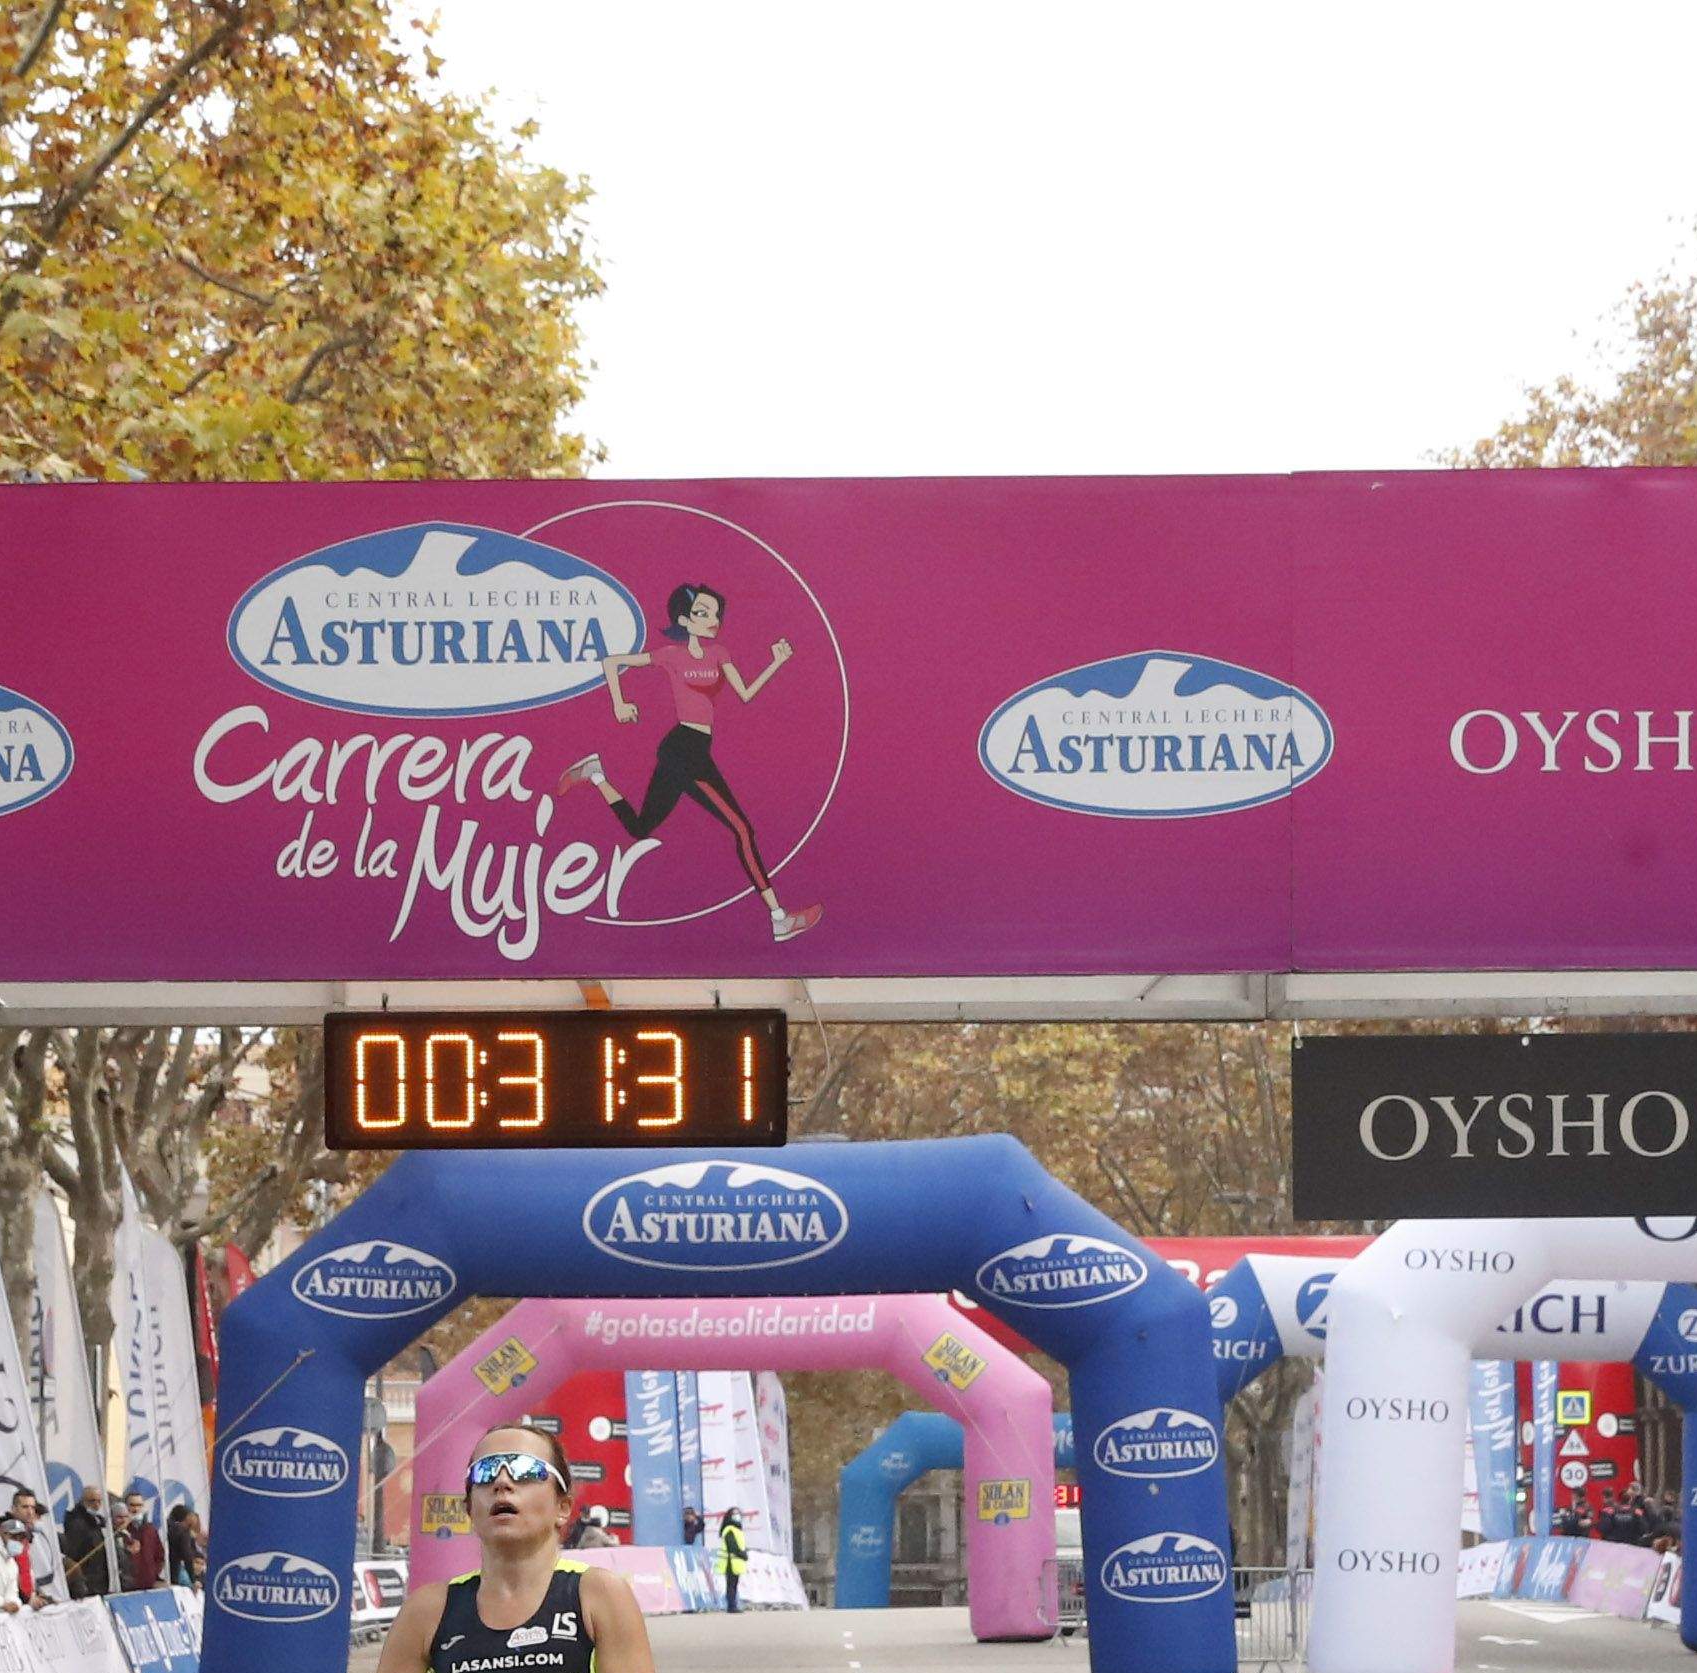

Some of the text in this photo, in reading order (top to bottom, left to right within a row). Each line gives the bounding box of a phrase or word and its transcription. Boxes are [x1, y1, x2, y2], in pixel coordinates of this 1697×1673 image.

[325, 588, 600, 609] CENTRAL LECHERA
[261, 594, 612, 668] ASTURIANA
[684, 668, 720, 681] OYSHO
[1062, 709, 1171, 725] CENTRAL
[193, 704, 535, 806] Carrera
[1007, 712, 1305, 776] ASTURIANA
[276, 793, 663, 962] de la Mujer
[1357, 1090, 1691, 1163] OYSHO
[644, 1192, 819, 1208] CENTRAL LECHERA
[604, 1196, 829, 1245] ASTURIANA
[990, 1259, 1135, 1295] ASTURIANA
[1403, 1248, 1515, 1275] OYSHO
[302, 1266, 444, 1301] ASTURIANA
[584, 1302, 876, 1347] #gotasdesolidaridad
[1212, 1338, 1267, 1361] RICH
[1346, 1397, 1450, 1424] OYSHO
[1102, 1431, 1214, 1463] ASTURIANA
[228, 1450, 341, 1483] ASTURIANA
[1564, 1469, 1585, 1481] 30
[1109, 1555, 1223, 1587] ASTURIANA
[1337, 1549, 1440, 1576] OYSHO
[219, 1574, 333, 1607] ASTURIANA
[551, 1611, 578, 1636] LS
